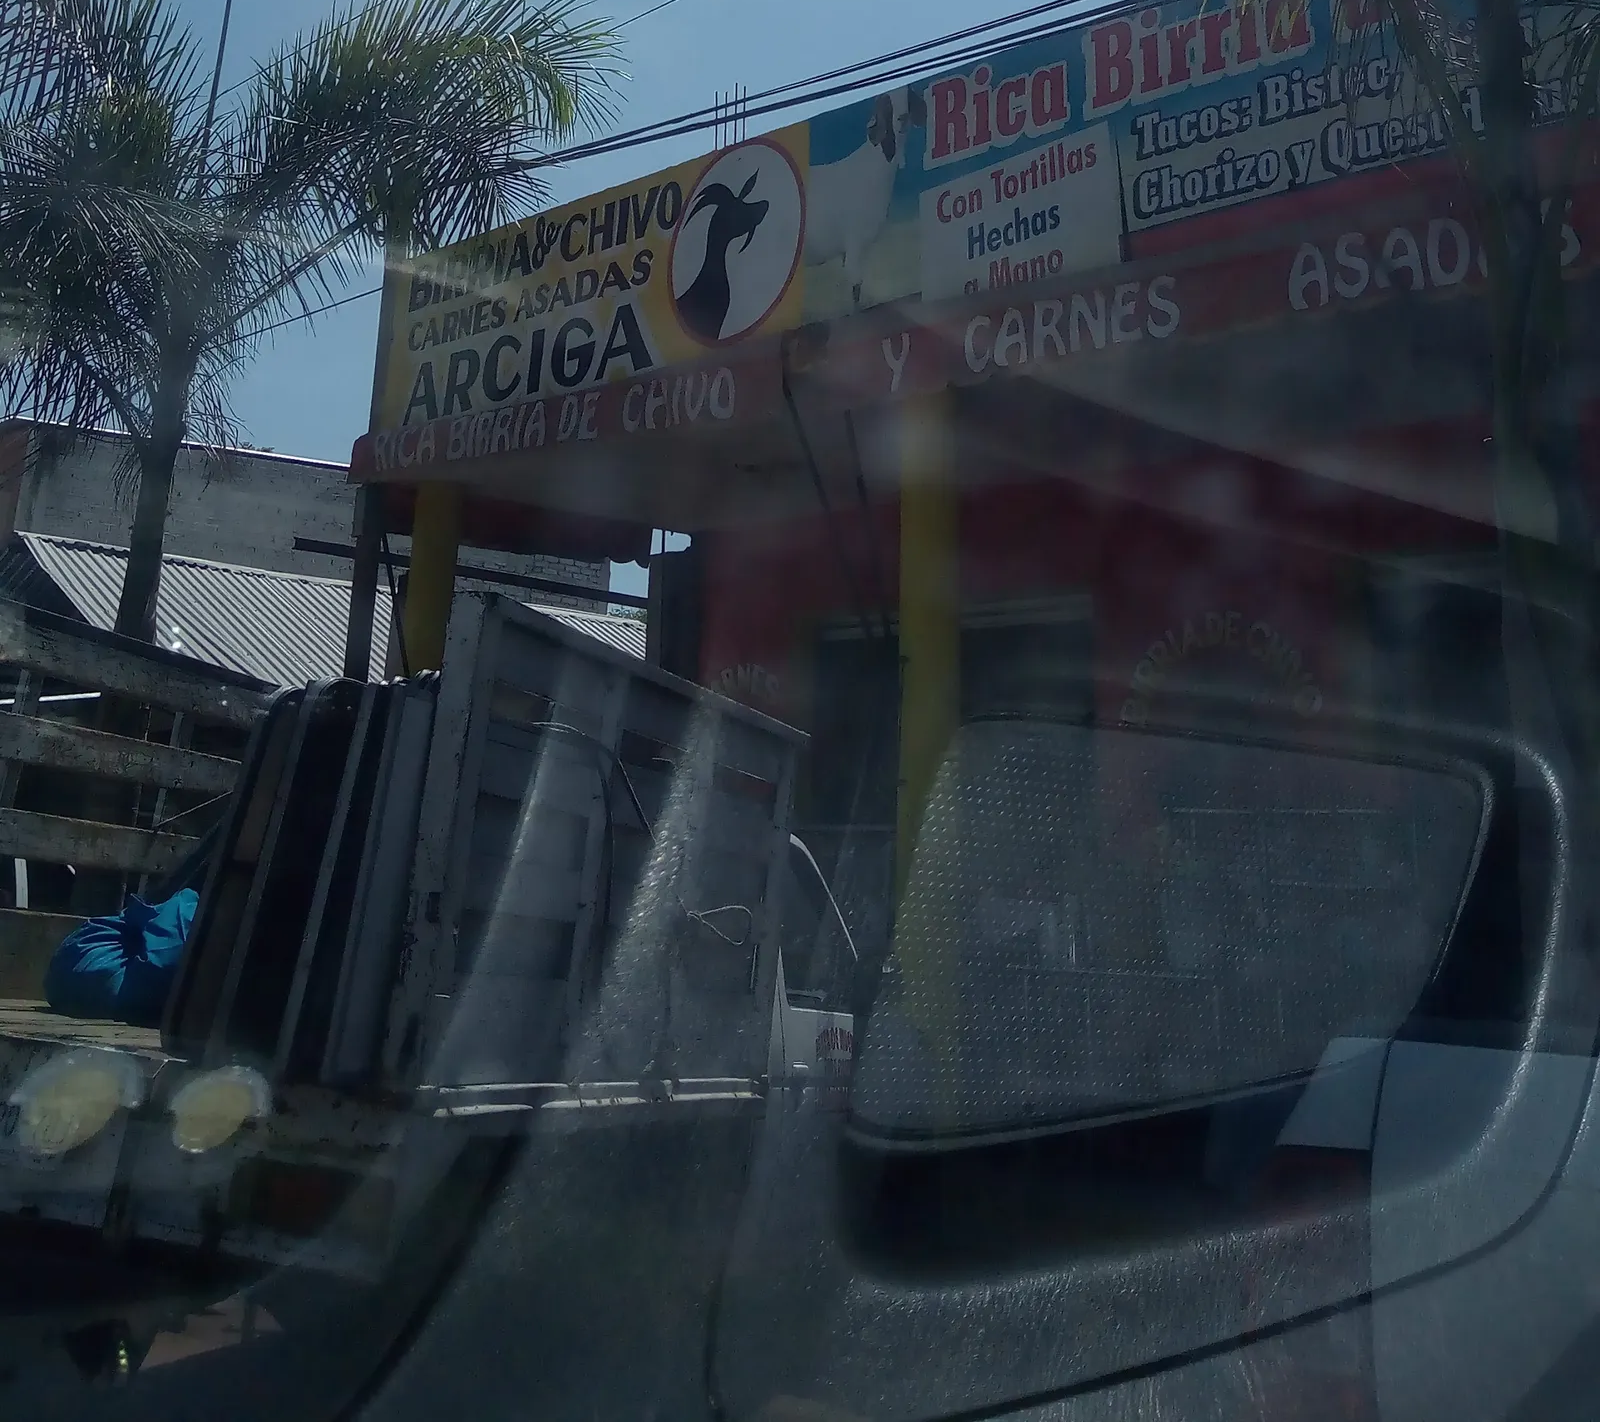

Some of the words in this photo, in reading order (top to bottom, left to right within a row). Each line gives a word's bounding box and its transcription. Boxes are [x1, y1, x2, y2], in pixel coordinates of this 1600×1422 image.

[930, 64, 1068, 161] Rica
[1133, 95, 1252, 161] Tacos:
[936, 186, 983, 224] Con
[990, 141, 1098, 205] Tortillas
[1134, 146, 1282, 220] Chorizo
[1285, 139, 1316, 187] y
[531, 215, 564, 271] de
[559, 180, 684, 263] CHIVO
[967, 204, 1061, 260] Hechas
[407, 296, 508, 352] CARNES
[512, 248, 654, 324] ASADAS
[964, 278, 979, 296] a
[988, 249, 1064, 292] Mano
[373, 420, 436, 472] RICA
[446, 399, 547, 461] BIRRIA
[555, 391, 602, 443] DE
[621, 366, 736, 434] CHIVO
[880, 332, 911, 394] Y
[963, 275, 1181, 374] CARNES
[402, 303, 655, 427] ARCIGA
